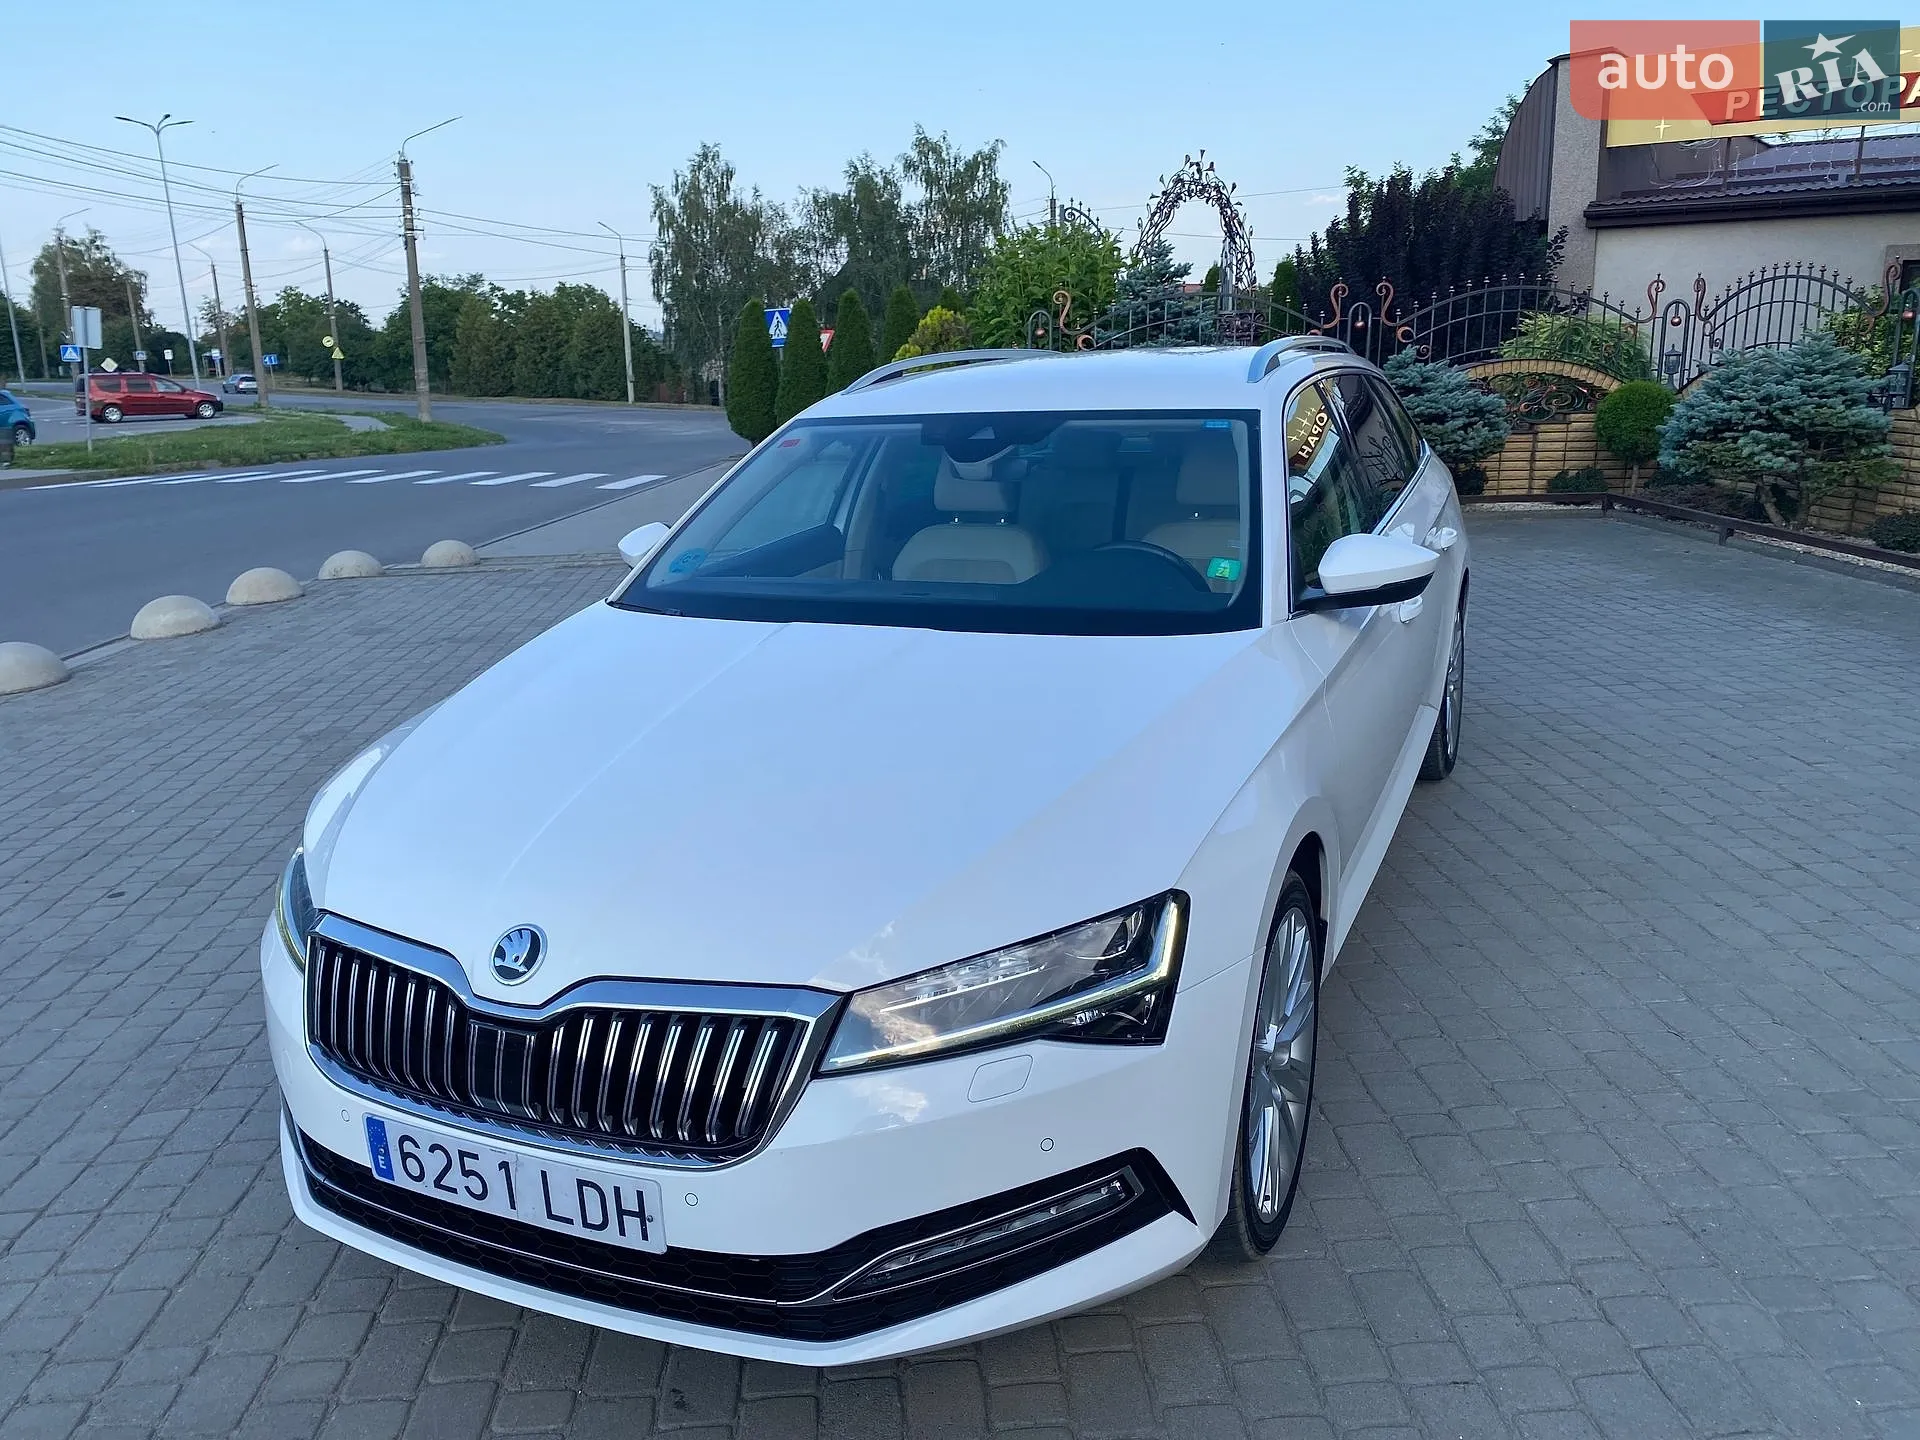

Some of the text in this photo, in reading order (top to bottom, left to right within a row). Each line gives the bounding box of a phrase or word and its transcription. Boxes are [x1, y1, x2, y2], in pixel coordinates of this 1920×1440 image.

[378, 1155, 387, 1169] E
[398, 1135, 649, 1241] 6251 LDH
